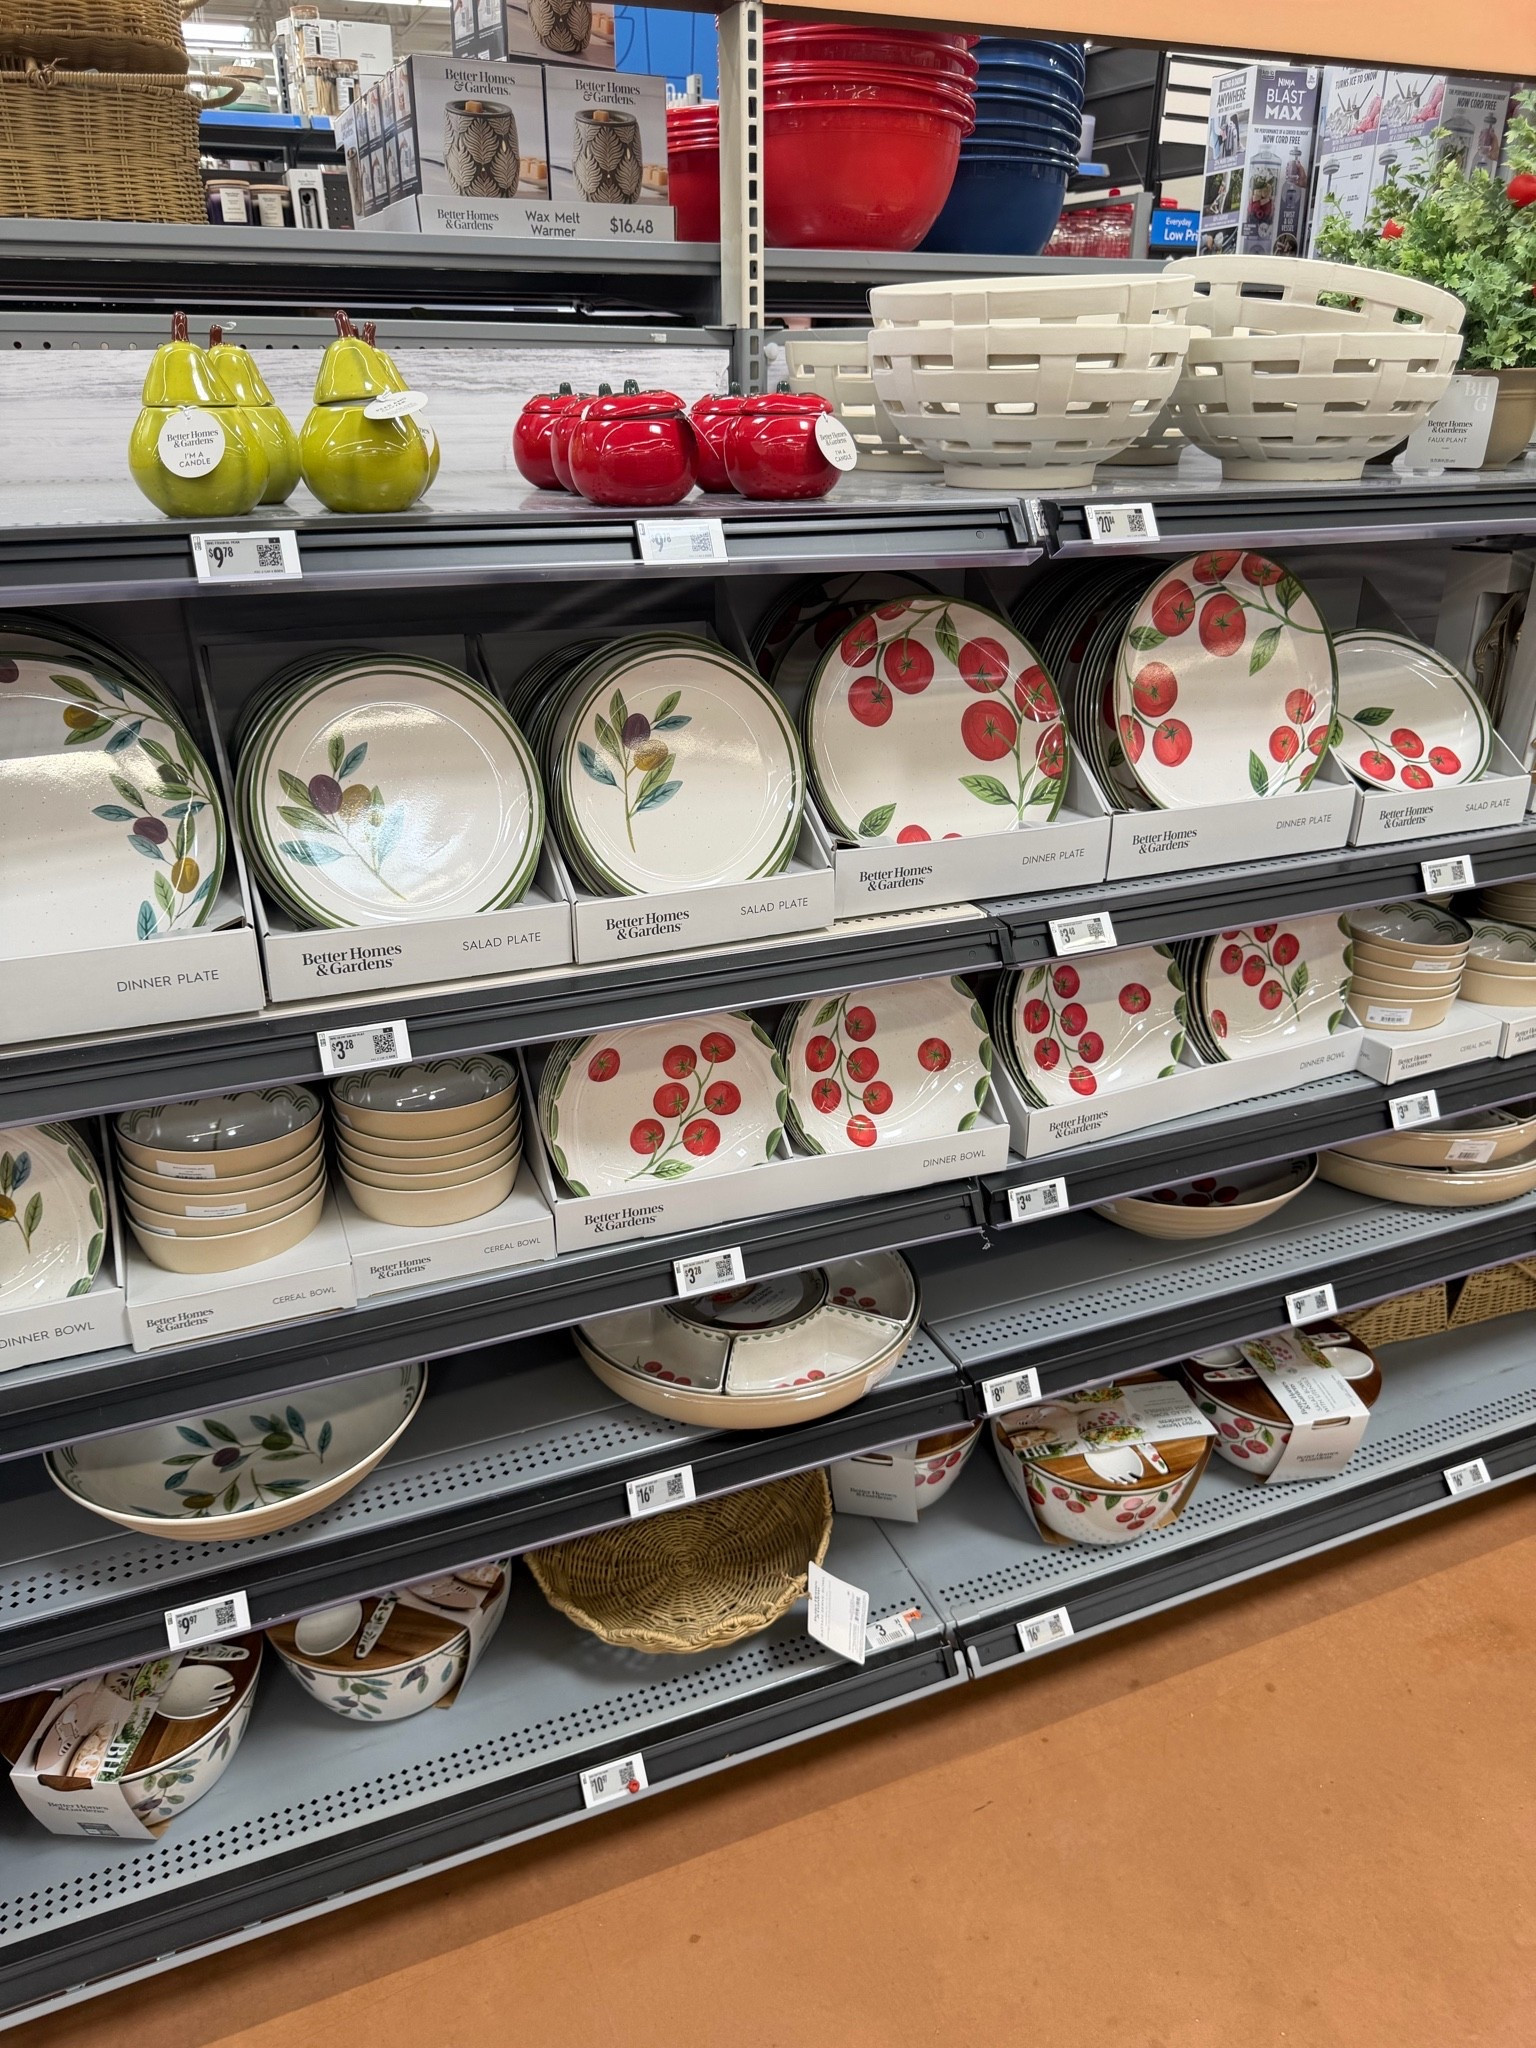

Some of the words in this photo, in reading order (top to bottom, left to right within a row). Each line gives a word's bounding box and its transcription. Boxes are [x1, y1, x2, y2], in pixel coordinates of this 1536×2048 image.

[445, 68, 478, 84] Better
[480, 71, 516, 85] Homes
[1278, 78, 1296, 88] NINJA
[1363, 71, 1378, 83] SNOW
[575, 79, 606, 92] Better
[607, 81, 640, 95] Homes
[1216, 87, 1246, 108] ANYWHERE
[1266, 88, 1307, 104] BLAST
[1456, 98, 1470, 108] NOW
[1471, 98, 1483, 110] CORD
[1485, 100, 1497, 110] FREE
[1264, 104, 1304, 120] MAX
[1275, 136, 1288, 144] CORD
[1289, 136, 1300, 145] FREE
[438, 209, 465, 220] Better
[466, 210, 499, 222] Homes
[525, 210, 550, 222] Wax
[555, 212, 580, 225] Melt
[610, 217, 654, 234] $16.48
[1284, 210, 1295, 218] TWIST
[530, 224, 576, 237] Warmer
[1165, 217, 1192, 228] Everyday
[1281, 224, 1294, 232] VESSEL
[1164, 229, 1183, 240] Low
[1428, 420, 1448, 428] Better
[167, 433, 190, 442] Better
[191, 430, 218, 438] Homes
[179, 458, 211, 468] CANDLE
[835, 454, 852, 462] CANDLE
[1380, 810, 1404, 820] Better
[1405, 805, 1434, 817] Homes
[1465, 802, 1488, 812] SALAD
[1490, 798, 1510, 809] PLATE
[1132, 833, 1162, 846] Better
[1163, 829, 1198, 841] Homes
[1276, 817, 1306, 829] DINNER
[1309, 814, 1332, 824] PLATE
[860, 870, 893, 882] Better
[894, 864, 933, 878] Homes
[1022, 853, 1056, 865] DINNER
[1059, 848, 1085, 860] PLATE
[606, 915, 644, 931] Better
[646, 910, 690, 925] Homes
[740, 902, 775, 916] SALAD
[779, 897, 809, 910] PLATE
[302, 949, 348, 966] Better
[350, 944, 402, 960] Homes
[462, 937, 502, 952] SALAD
[507, 932, 541, 945] PLATE
[117, 976, 172, 992] DINNER
[177, 970, 219, 984] PLATE
[1300, 1056, 1325, 1070] DINNER
[1326, 1051, 1346, 1062] BOWL
[1398, 1058, 1413, 1066] Better
[1413, 1052, 1432, 1062] Homes
[1460, 1043, 1477, 1052] CEREAL
[1478, 1040, 1492, 1049] BOWL
[1049, 1118, 1076, 1132] Better
[1077, 1110, 1109, 1125] Homes
[923, 1154, 957, 1168] DINNER
[960, 1149, 986, 1160] BOWL
[584, 1212, 620, 1225] Better
[622, 1204, 664, 1218] Homes
[484, 1242, 514, 1254] CEREAL
[517, 1237, 541, 1248] BOWL
[370, 1262, 398, 1275] Better
[400, 1256, 432, 1269] Homes
[272, 1292, 306, 1305] CEREAL
[310, 1286, 336, 1298] BOWL
[146, 1314, 177, 1328] Better
[178, 1307, 214, 1322] Homes
[54, 1322, 95, 1338] BOWL
[76, 1802, 109, 1810] Homes
